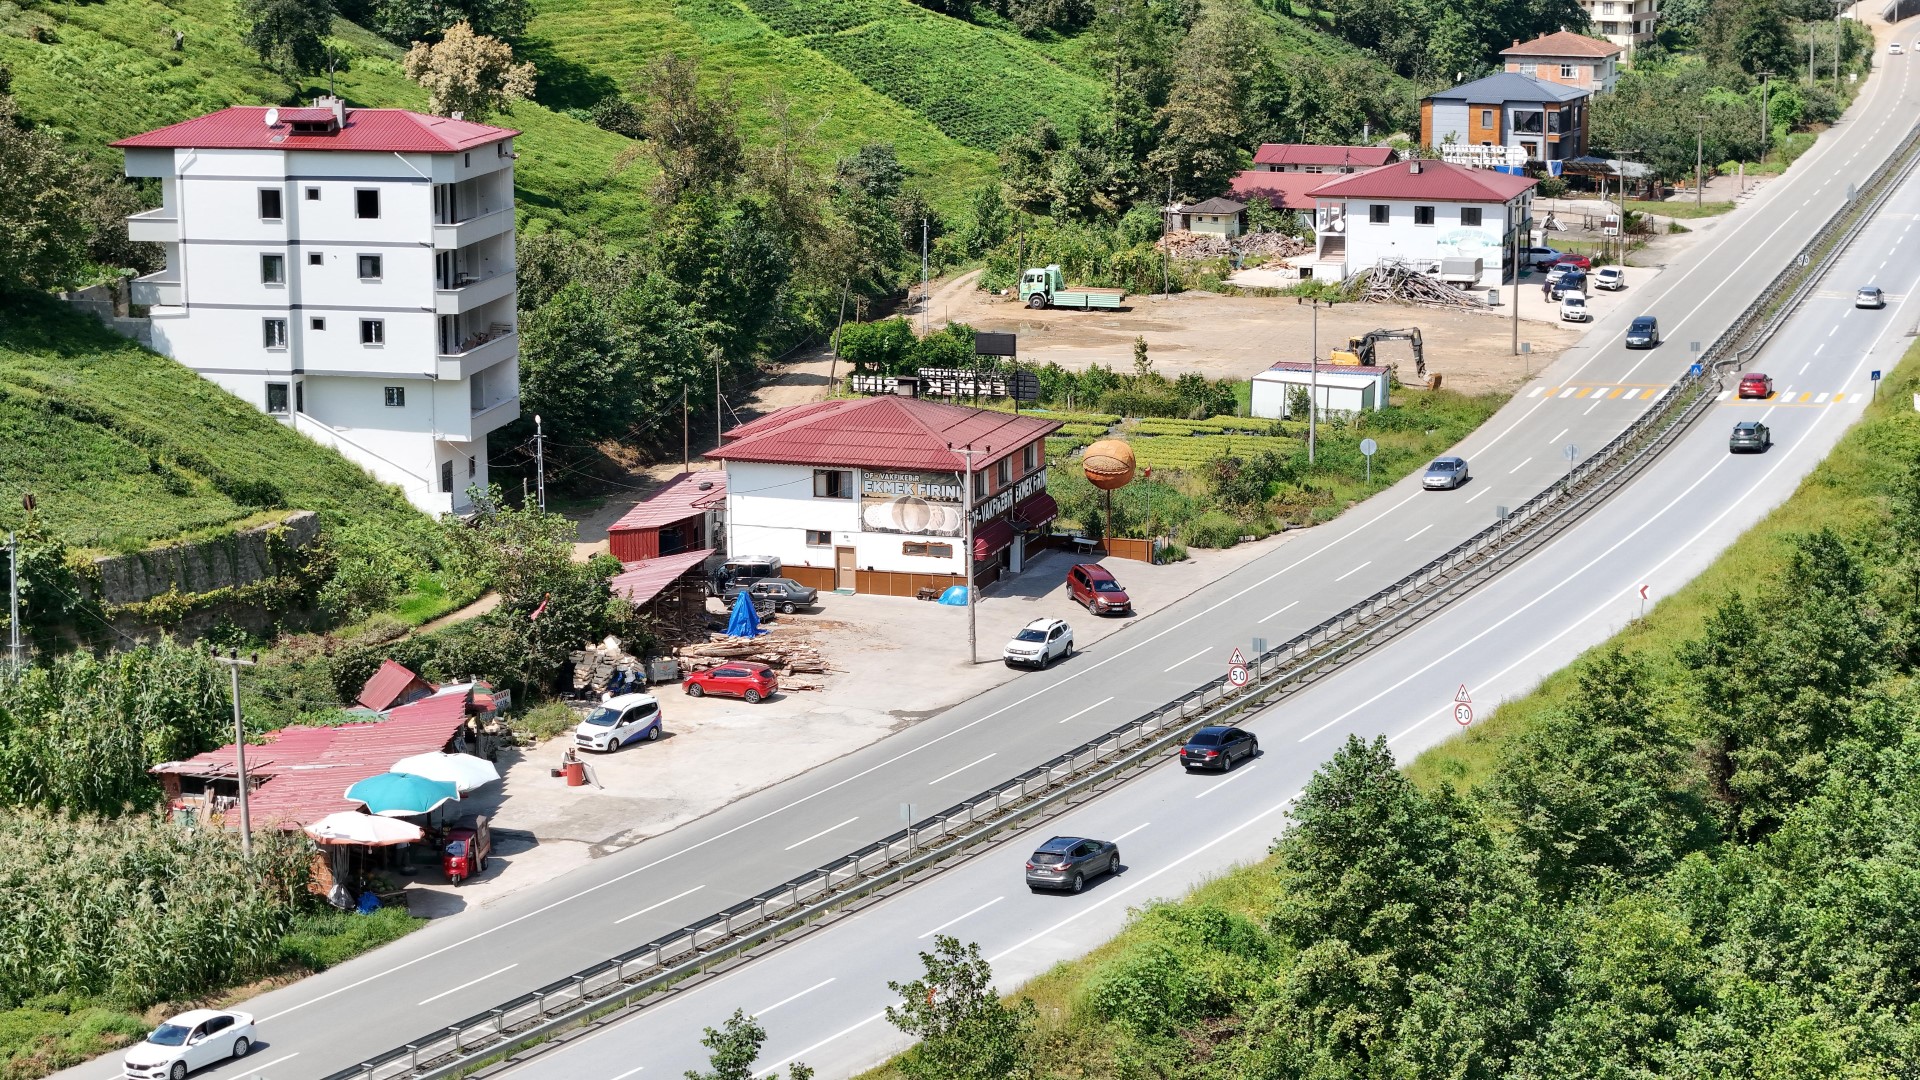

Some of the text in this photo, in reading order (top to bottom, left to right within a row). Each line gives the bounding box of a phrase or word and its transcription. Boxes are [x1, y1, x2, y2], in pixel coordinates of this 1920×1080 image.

[864, 480, 961, 498] EKMEK FIRINI
[1015, 476, 1033, 503] EKMEK
[1232, 670, 1245, 681] 50
[1457, 708, 1470, 720] 50
